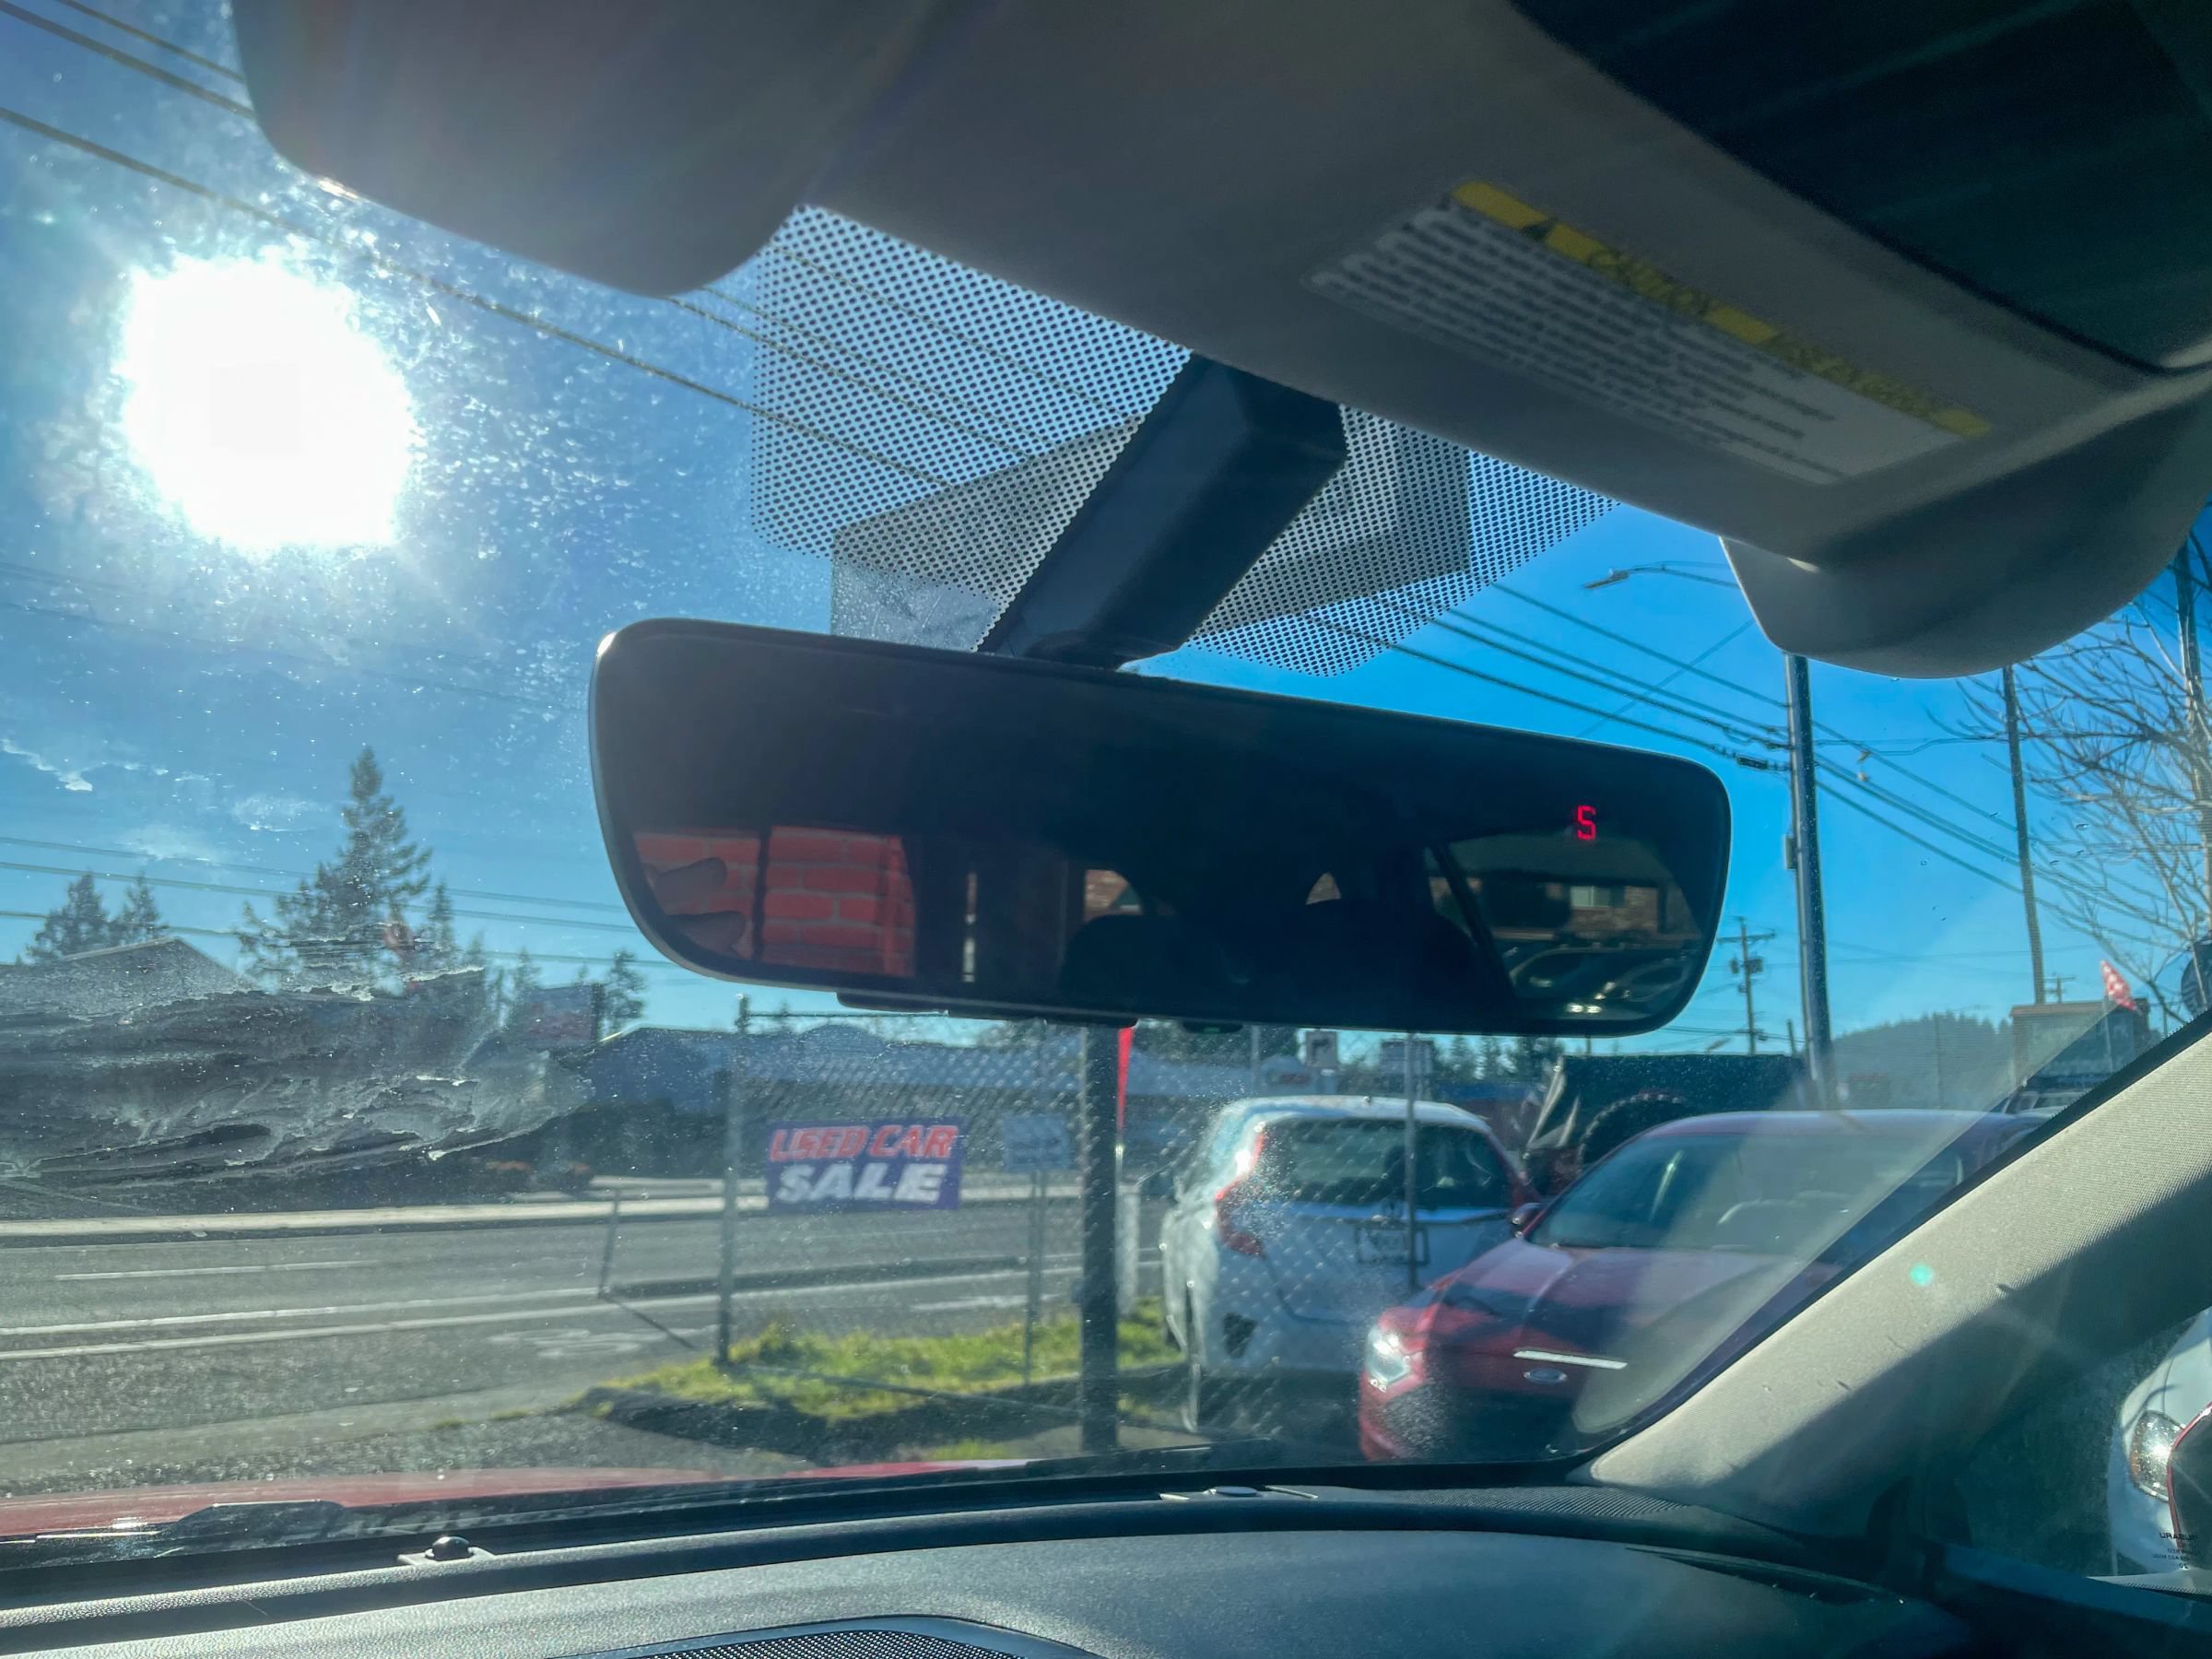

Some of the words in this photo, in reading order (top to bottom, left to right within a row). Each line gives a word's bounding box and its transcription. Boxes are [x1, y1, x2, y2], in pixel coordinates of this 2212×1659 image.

[1577, 805, 1596, 841] S
[769, 1126, 869, 1161] USED
[869, 1124, 959, 1158] CAR
[776, 1163, 947, 1202] SALE
